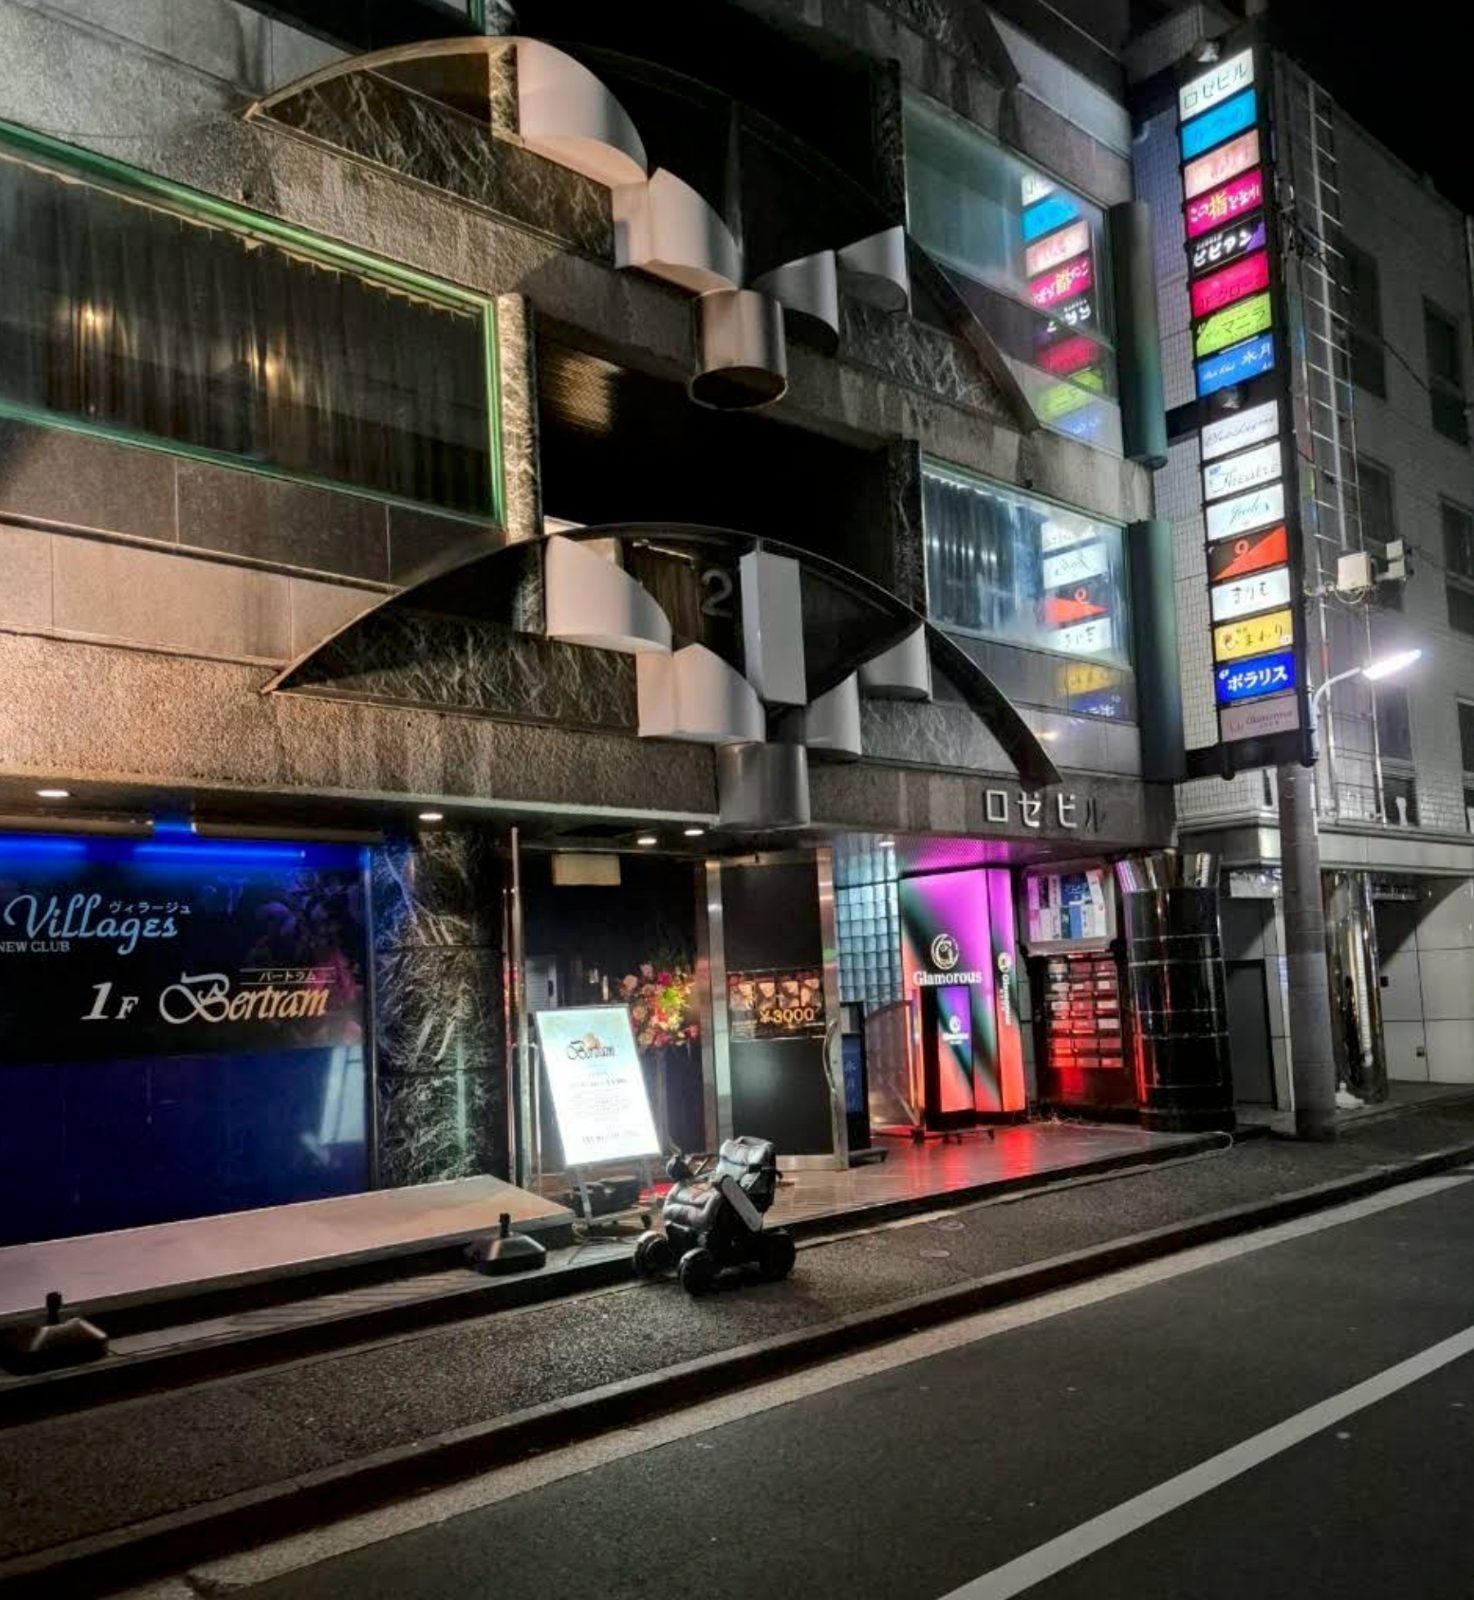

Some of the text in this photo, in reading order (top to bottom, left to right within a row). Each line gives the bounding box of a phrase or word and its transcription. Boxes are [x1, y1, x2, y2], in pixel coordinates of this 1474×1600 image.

[701, 568, 733, 618] 2
[1227, 665, 1288, 692] ポラリス
[108, 900, 192, 916] ヴィラージュ
[3, 893, 180, 956] Villages
[31, 940, 71, 954] CLUB
[912, 970, 983, 986] Glamorous
[159, 972, 330, 1025] Bertram
